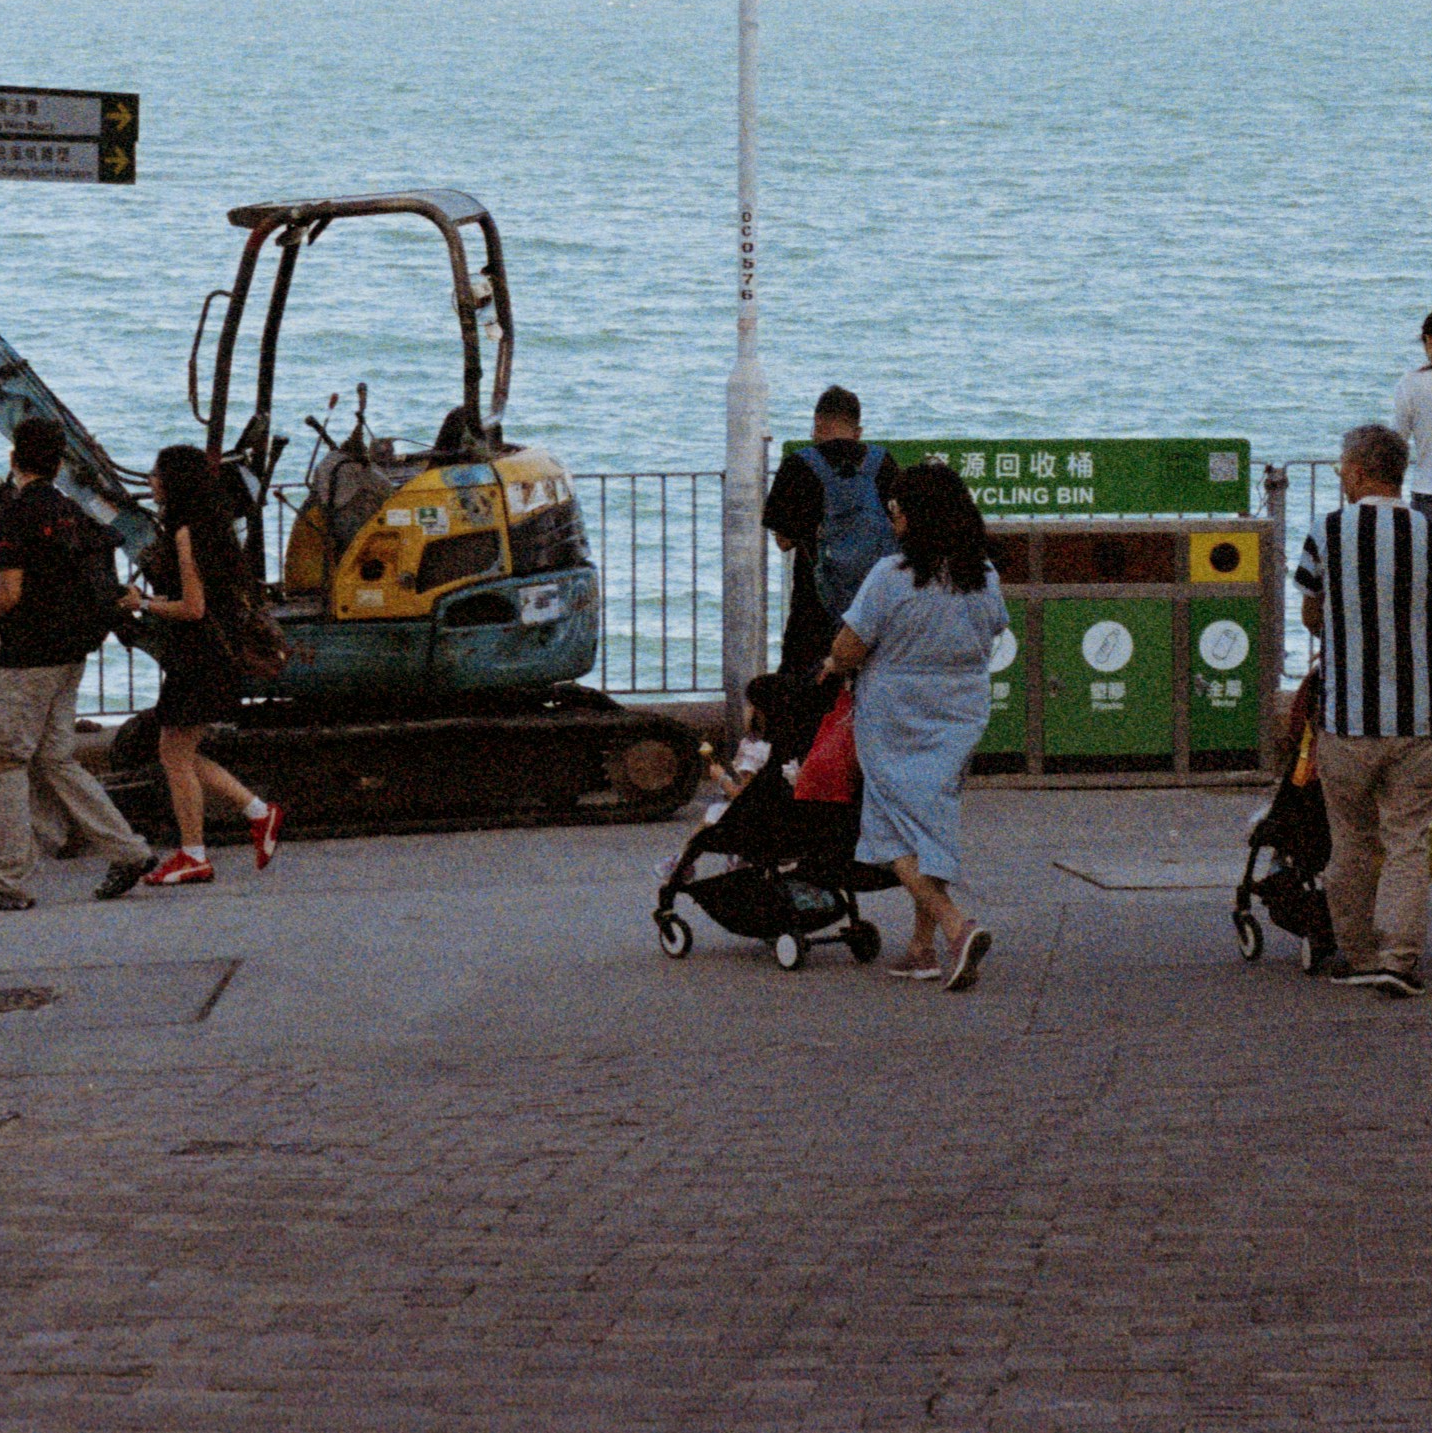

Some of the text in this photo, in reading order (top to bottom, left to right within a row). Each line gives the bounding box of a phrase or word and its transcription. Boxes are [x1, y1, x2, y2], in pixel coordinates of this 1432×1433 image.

[4, 119, 26, 129] Wan
[26, 120, 55, 131] Beach
[968, 487, 1094, 505] YCLING BIN
